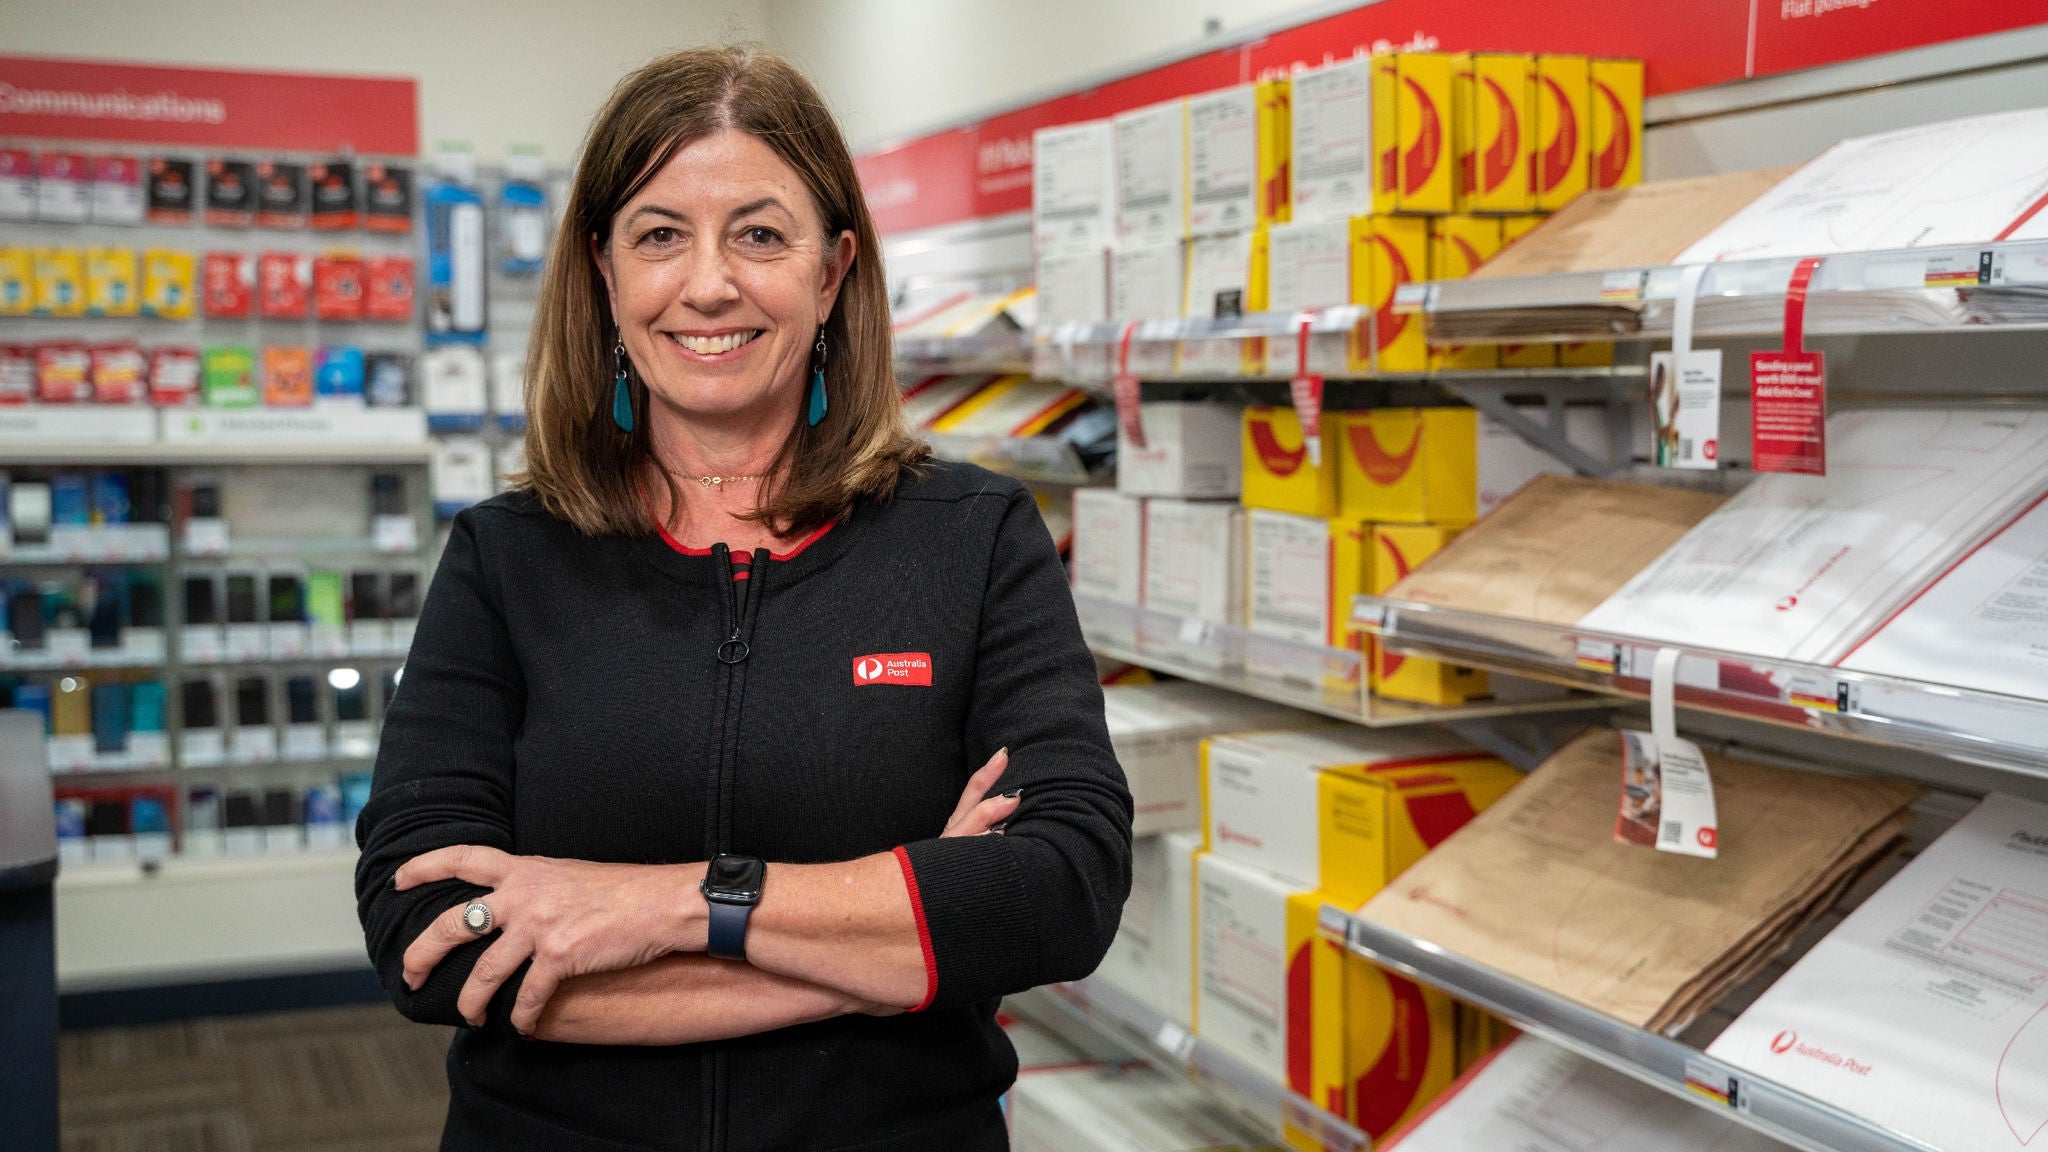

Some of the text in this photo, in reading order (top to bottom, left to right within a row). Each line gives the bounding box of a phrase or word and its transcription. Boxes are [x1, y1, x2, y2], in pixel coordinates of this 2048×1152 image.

[887, 660, 927, 677] Australia Post
[1796, 1042, 1872, 1077] Australia Post
